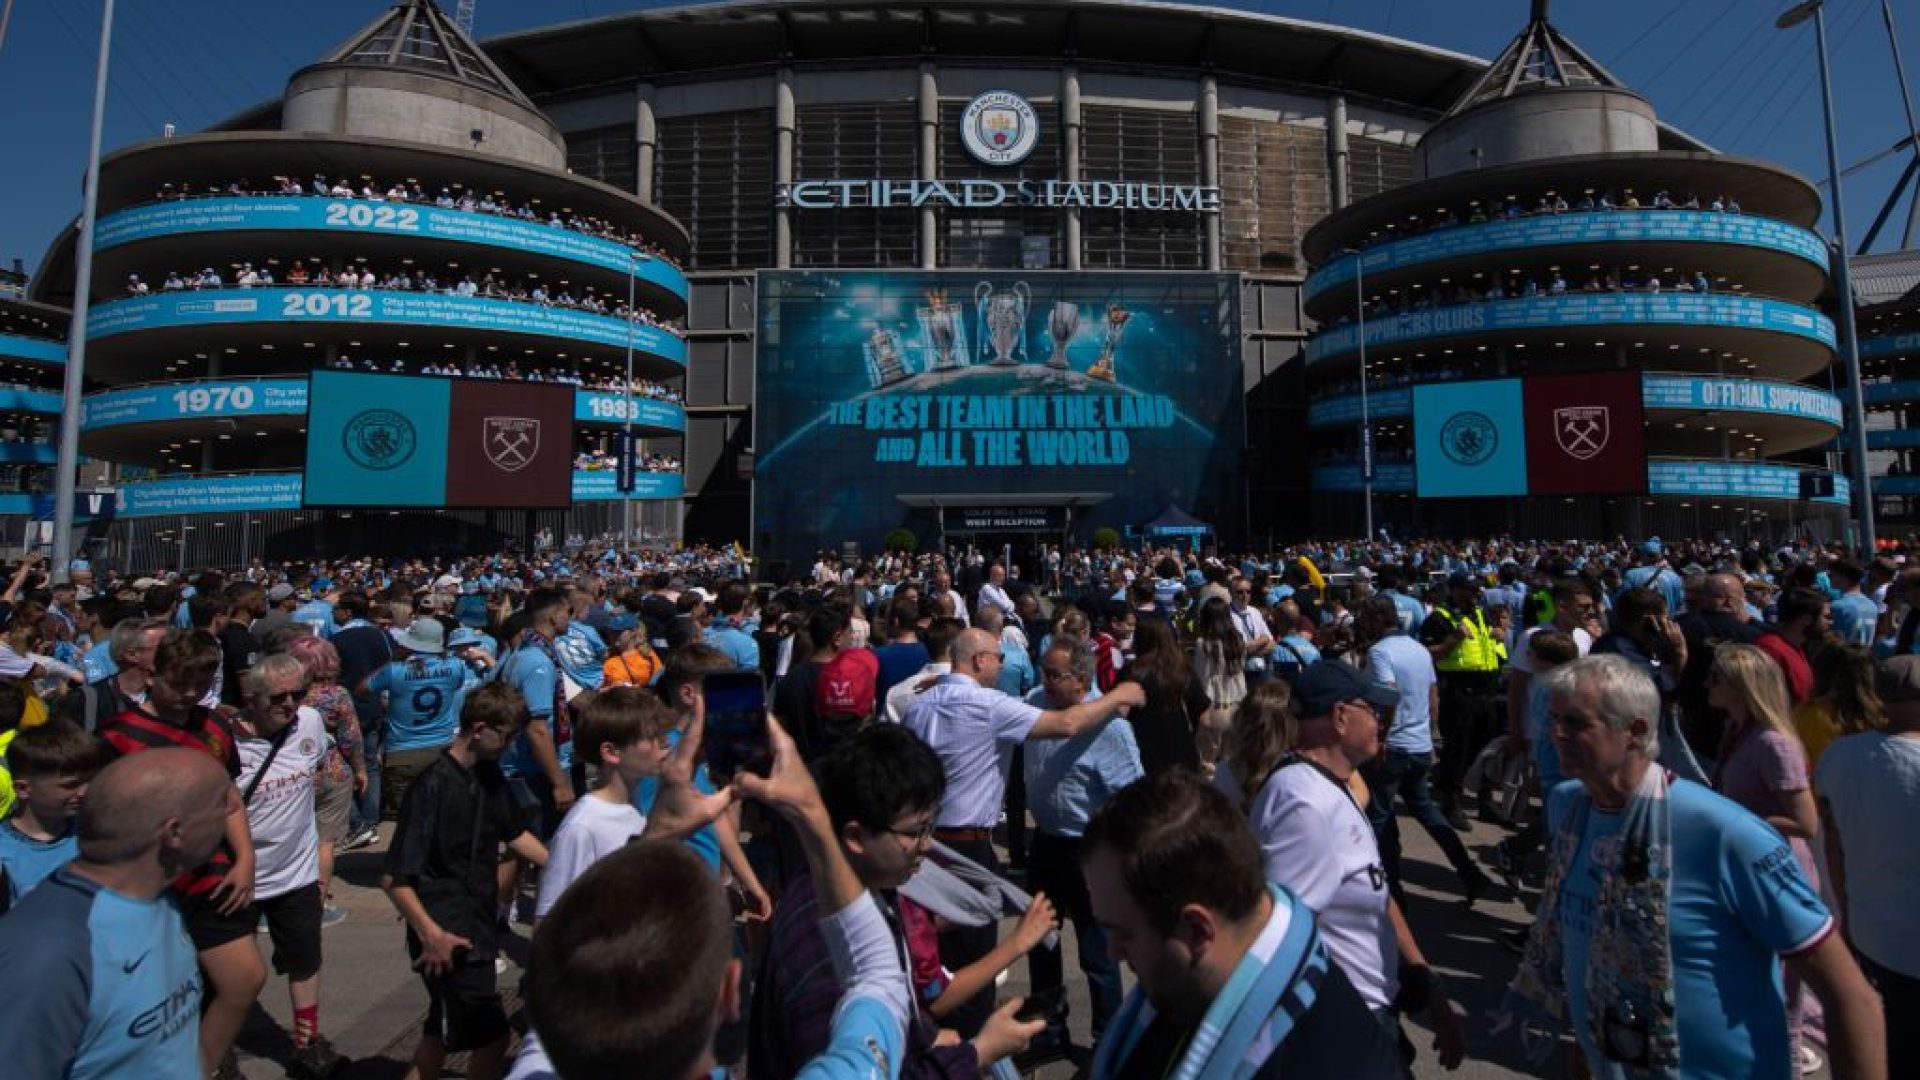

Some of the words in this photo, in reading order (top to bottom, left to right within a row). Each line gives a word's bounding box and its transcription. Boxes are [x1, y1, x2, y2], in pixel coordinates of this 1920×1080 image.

[968, 94, 1031, 118] MANCHESTER
[988, 152, 1011, 161] CITY
[792, 179, 1006, 209] ETIHAD
[1017, 179, 1205, 211] STADIUM
[326, 203, 418, 231] 2022
[282, 294, 372, 317] 2012
[1434, 307, 1485, 334] CLUBS
[173, 386, 254, 414] 1970
[265, 388, 285, 398] City
[1702, 382, 1767, 408] OFFICIAL
[830, 402, 864, 425] THE
[865, 396, 935, 430] BEST
[939, 396, 1013, 429] TEAM
[1018, 396, 1045, 428] IN
[1046, 396, 1098, 428] THE
[1105, 396, 1173, 428] LAND
[875, 438, 915, 462] AND
[917, 432, 967, 467] ALL
[972, 431, 1022, 466] THE
[1027, 431, 1130, 465] WORLD
[178, 486, 206, 496] Bolton
[207, 485, 261, 496] Wanderers
[89, 494, 103, 514] V
[966, 518, 991, 527] WEST
[993, 518, 1047, 527] RECEPTION
[412, 685, 444, 727] 9
